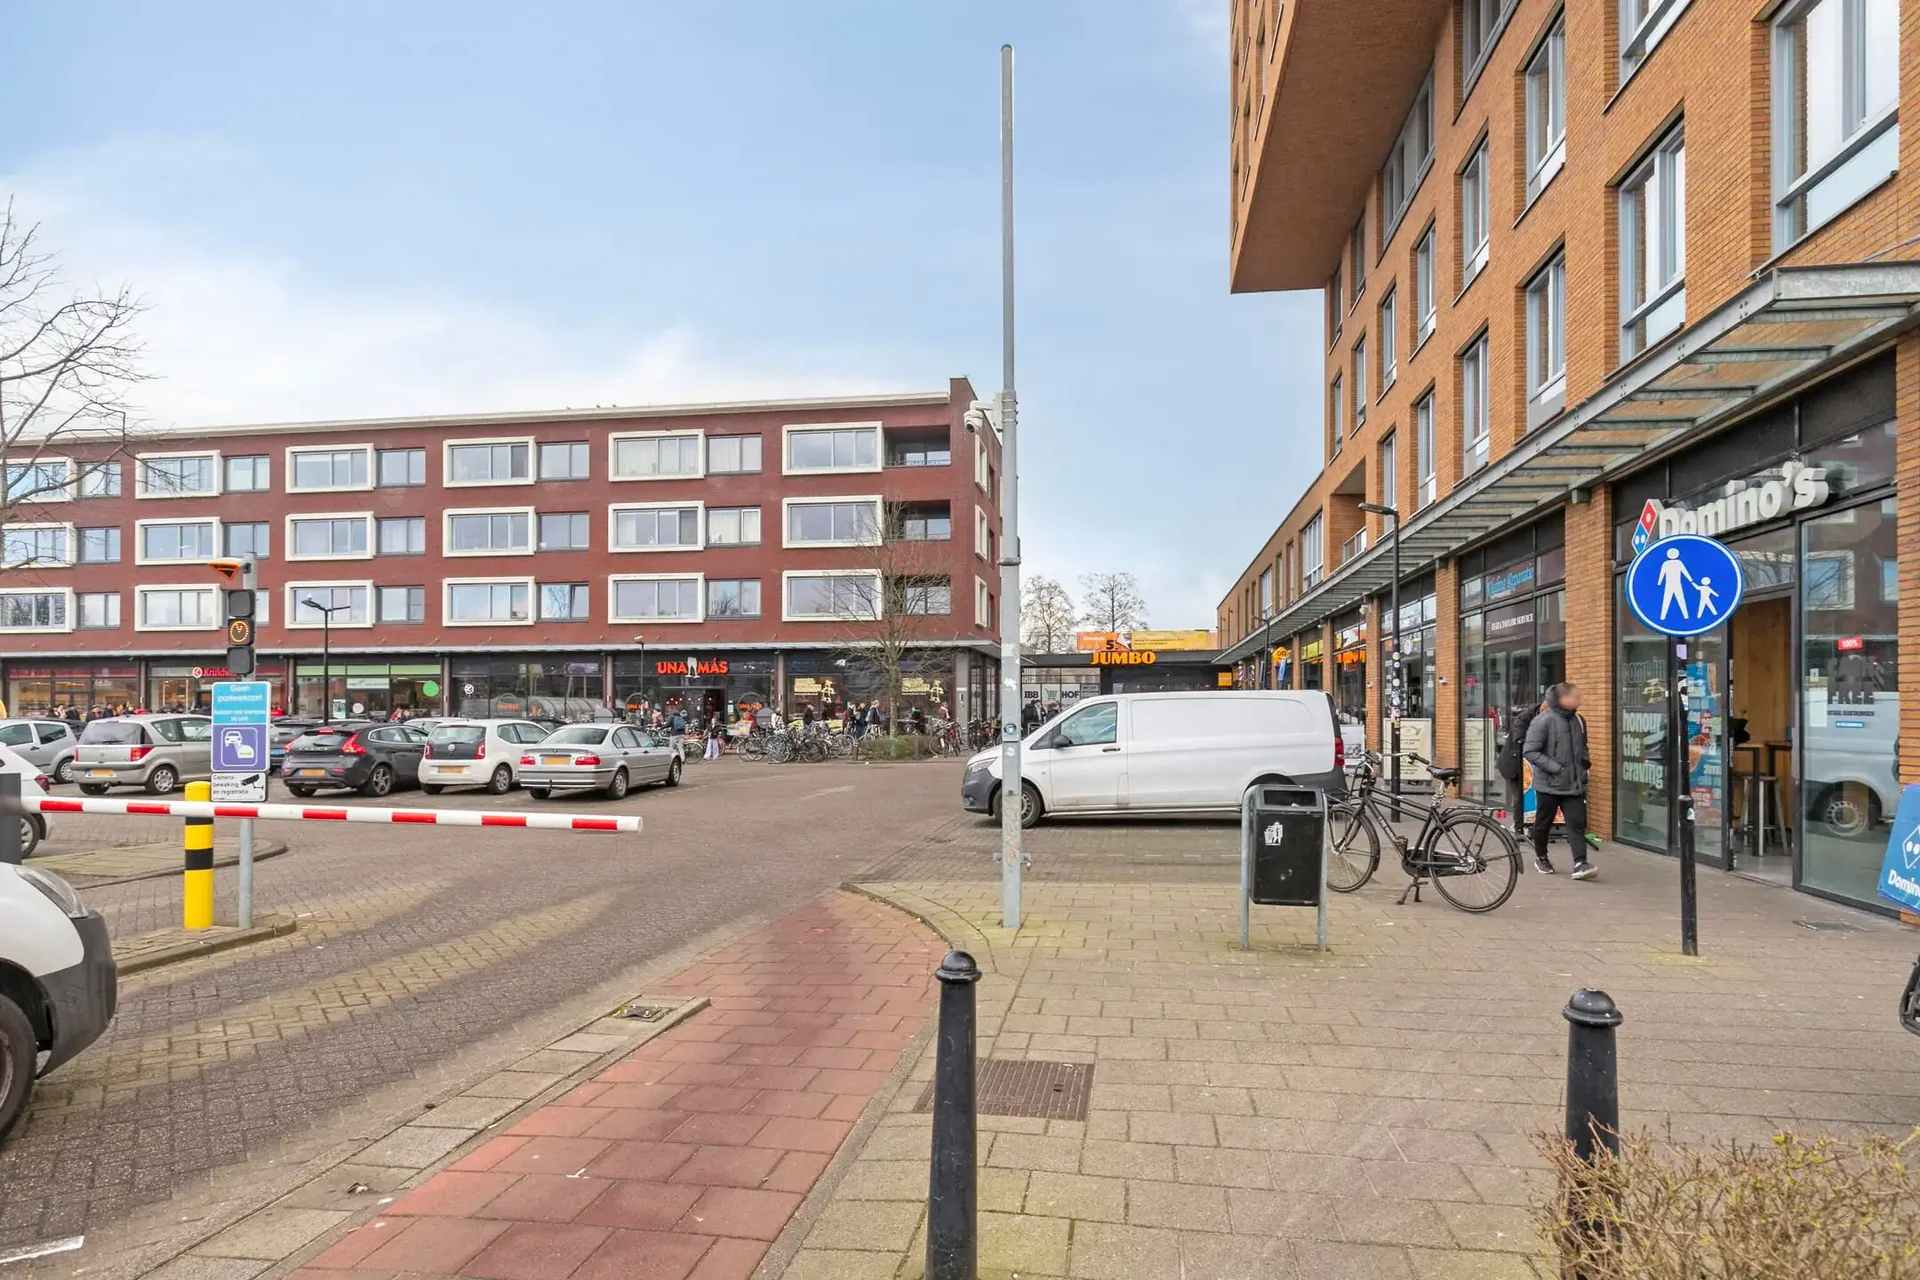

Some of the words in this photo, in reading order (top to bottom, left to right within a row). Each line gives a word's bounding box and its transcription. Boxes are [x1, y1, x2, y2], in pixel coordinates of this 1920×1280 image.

[1659, 461, 1829, 539] Domino's
[1517, 613, 1535, 626] SERVICE
[1841, 640, 1859, 648] 100%
[656, 661, 687, 674] UNA
[697, 657, 729, 674] MÁS
[1090, 651, 1157, 665] JUMBO
[1061, 690, 1080, 698] HOF
[1622, 710, 1663, 733] honour
[1622, 734, 1642, 758] the
[1622, 760, 1664, 790] craving
